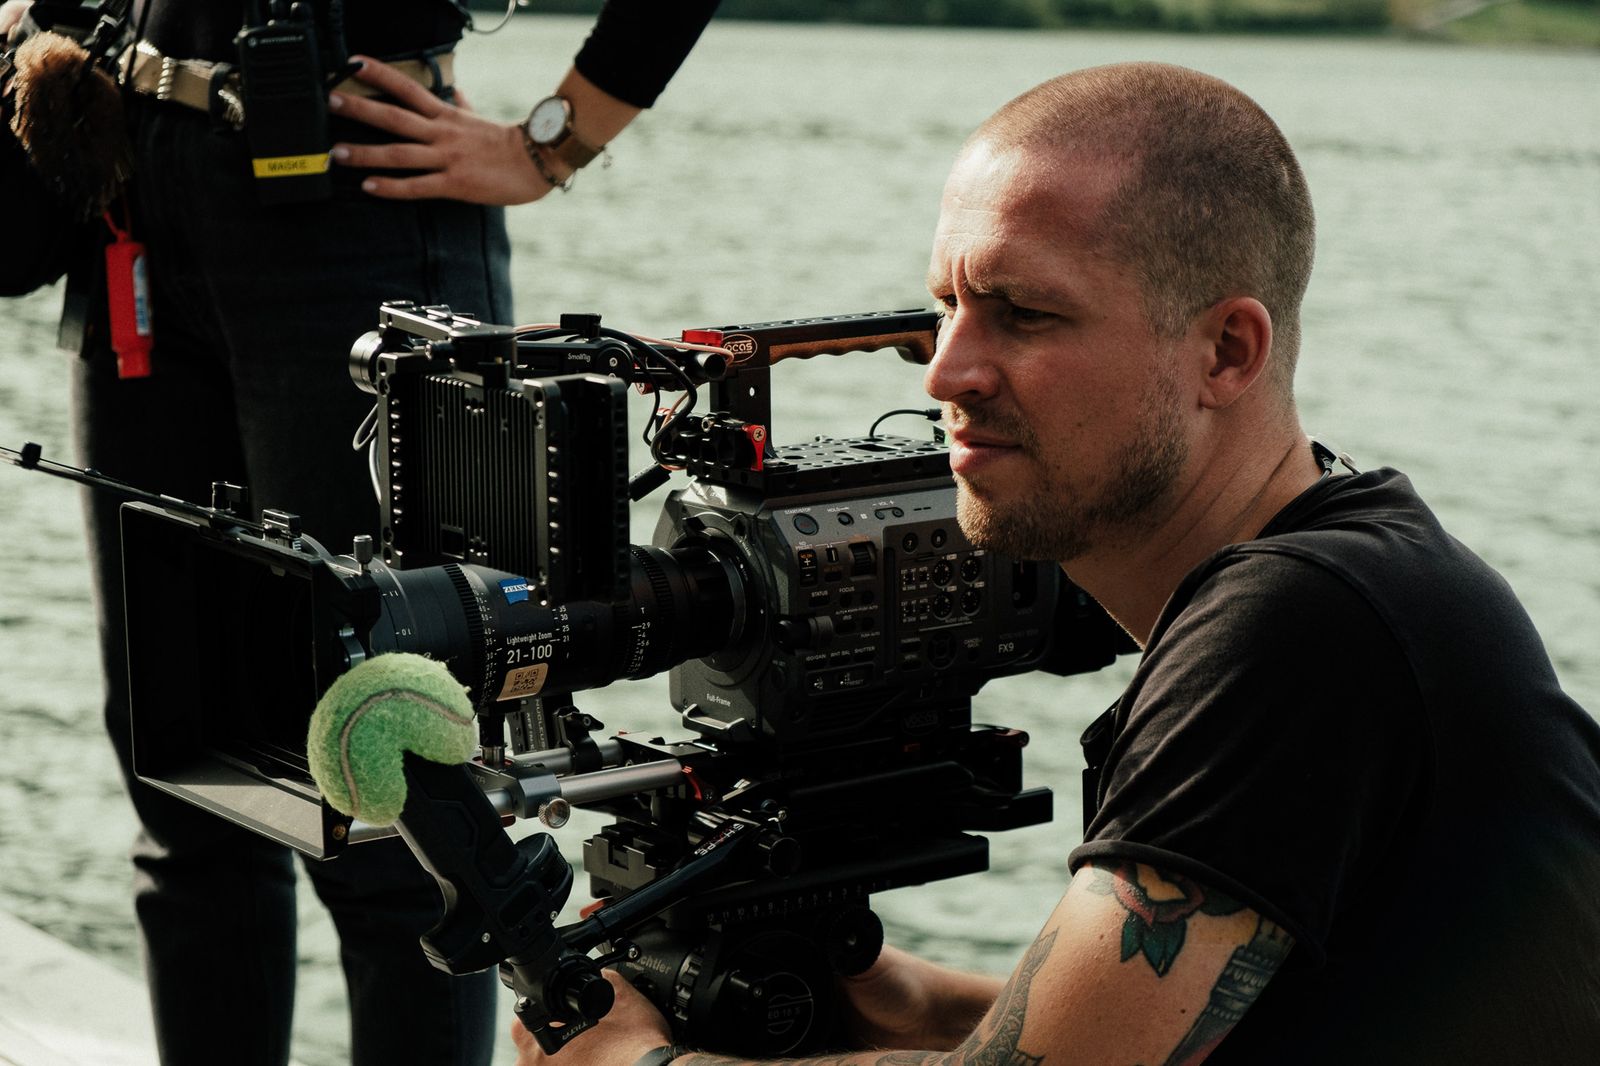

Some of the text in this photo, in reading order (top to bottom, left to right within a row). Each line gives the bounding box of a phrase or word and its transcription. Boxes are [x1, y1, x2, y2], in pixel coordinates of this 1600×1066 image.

[503, 584, 528, 593] ZEISS
[559, 605, 567, 613] 35
[507, 632, 552, 646] Lightweight Zoom
[507, 644, 553, 664] 21-100
[998, 642, 1015, 654] FX9
[707, 693, 731, 707] Full-Frame
